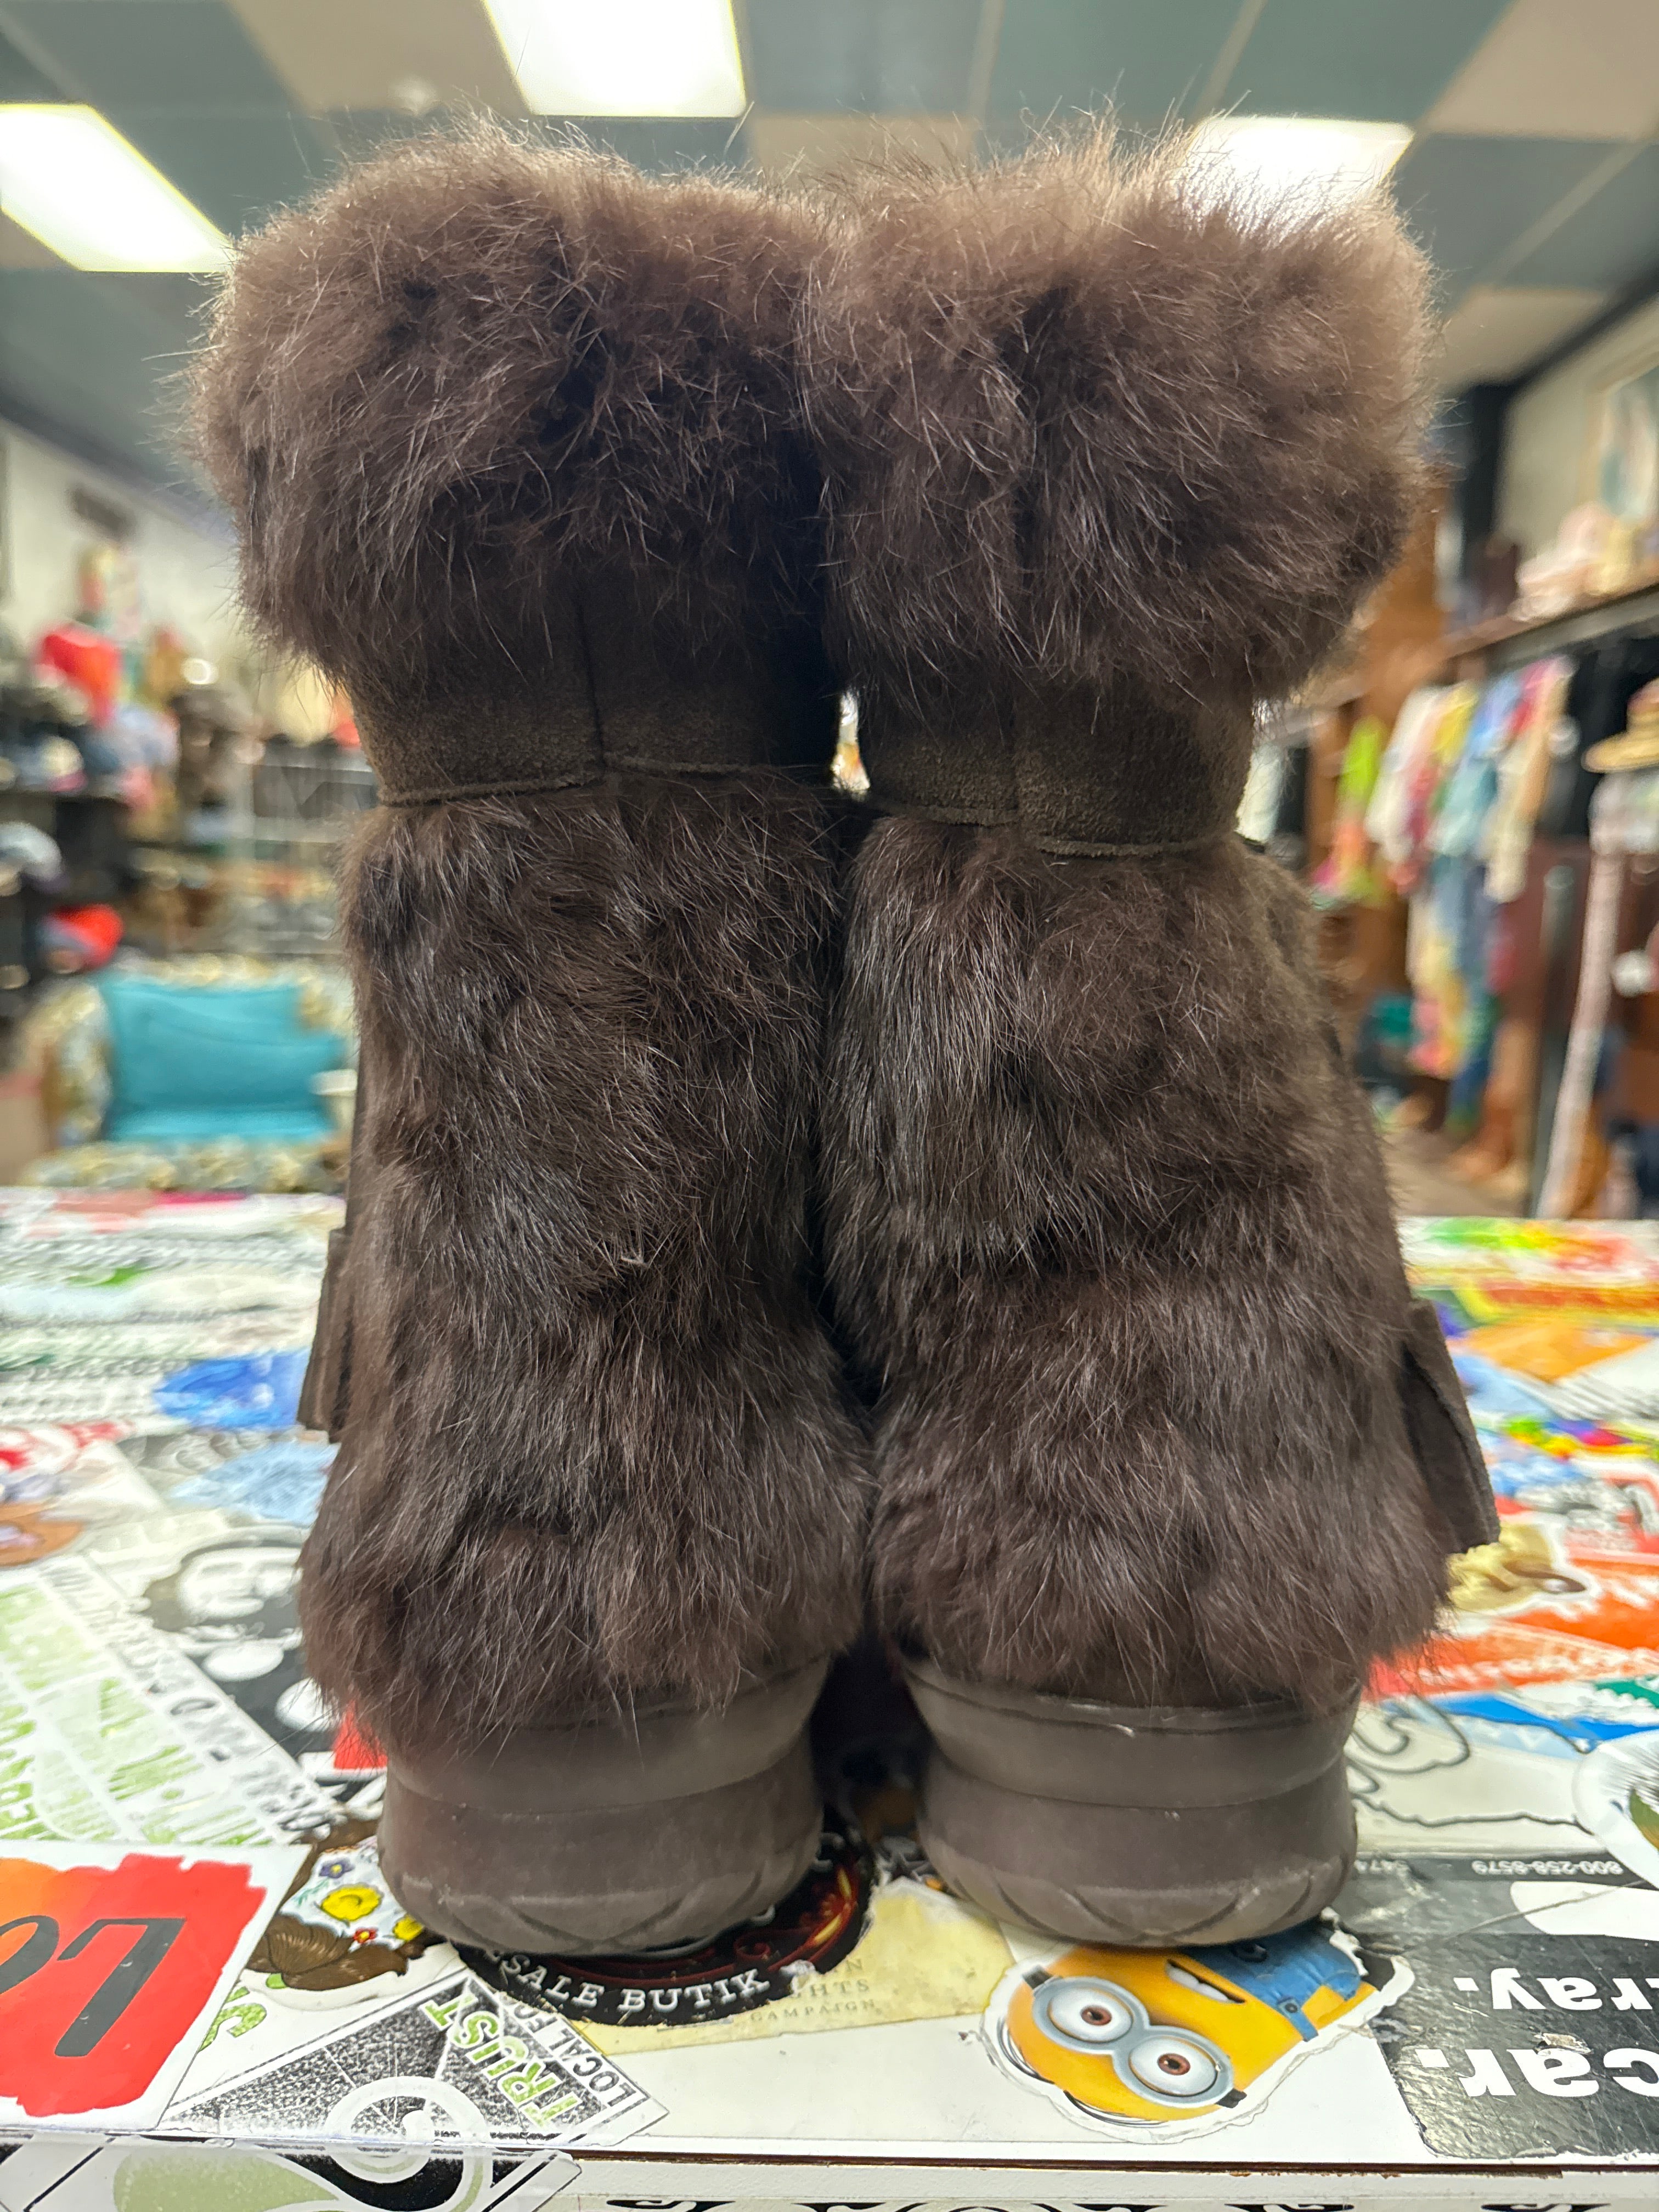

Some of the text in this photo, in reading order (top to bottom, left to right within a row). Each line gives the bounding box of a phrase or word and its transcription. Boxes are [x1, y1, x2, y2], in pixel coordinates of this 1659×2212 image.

[618, 1967, 770, 2012] BUTIK
[795, 1978, 871, 1997] HTS
[422, 1994, 581, 2129] TRUST
[548, 2027, 636, 2108] LOCAL
